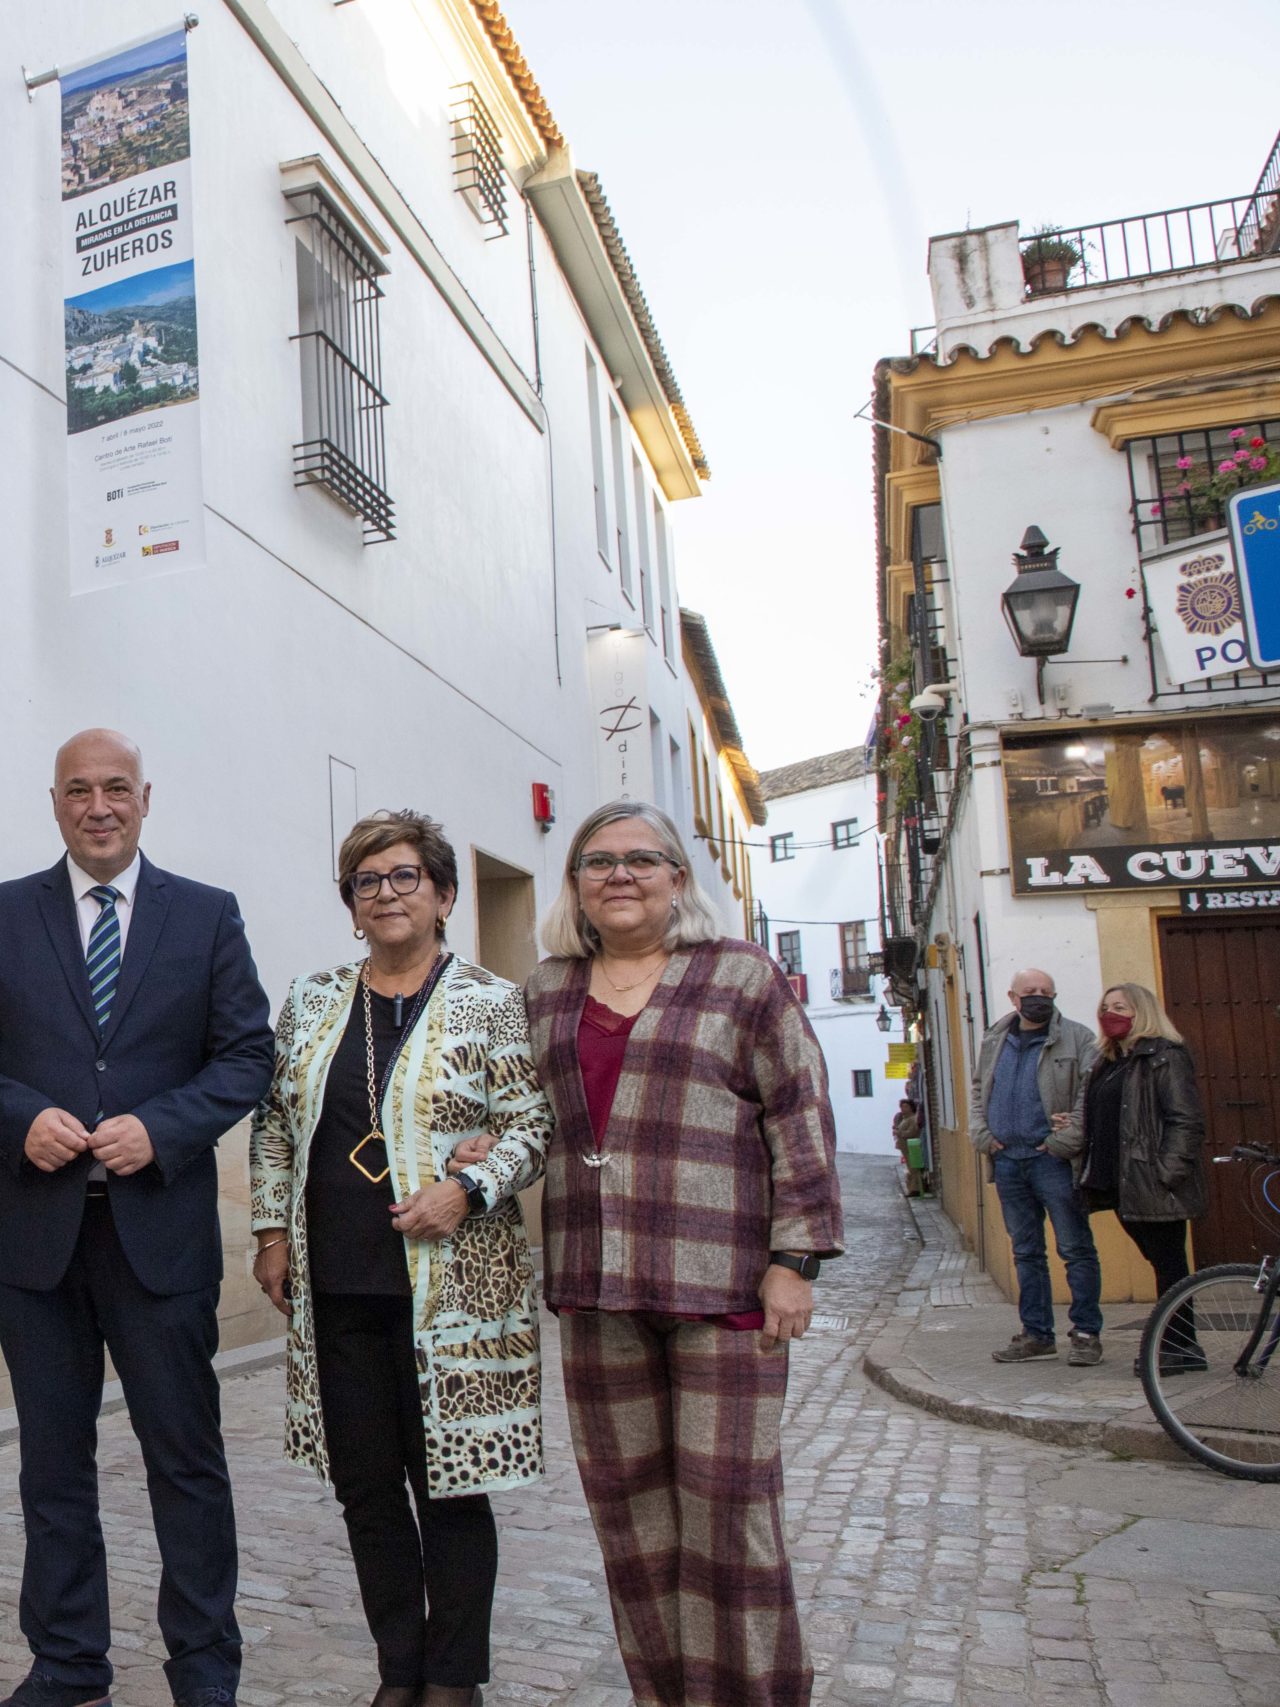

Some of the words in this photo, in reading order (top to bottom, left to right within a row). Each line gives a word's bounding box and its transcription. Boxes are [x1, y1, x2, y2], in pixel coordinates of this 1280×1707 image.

[76, 180, 176, 232] ALQUÉZAR
[81, 229, 112, 247] MIRADAS
[114, 225, 123, 235] EN
[124, 221, 133, 231] LA
[134, 209, 173, 228] DISTANCIA
[82, 229, 173, 276] ZUHEROS
[94, 450, 113, 462] Centro
[114, 448, 123, 456] de
[123, 444, 136, 453] Arte
[137, 439, 158, 449] Rafael
[1026, 855, 1110, 886] LA
[1127, 845, 1280, 881] CUEV
